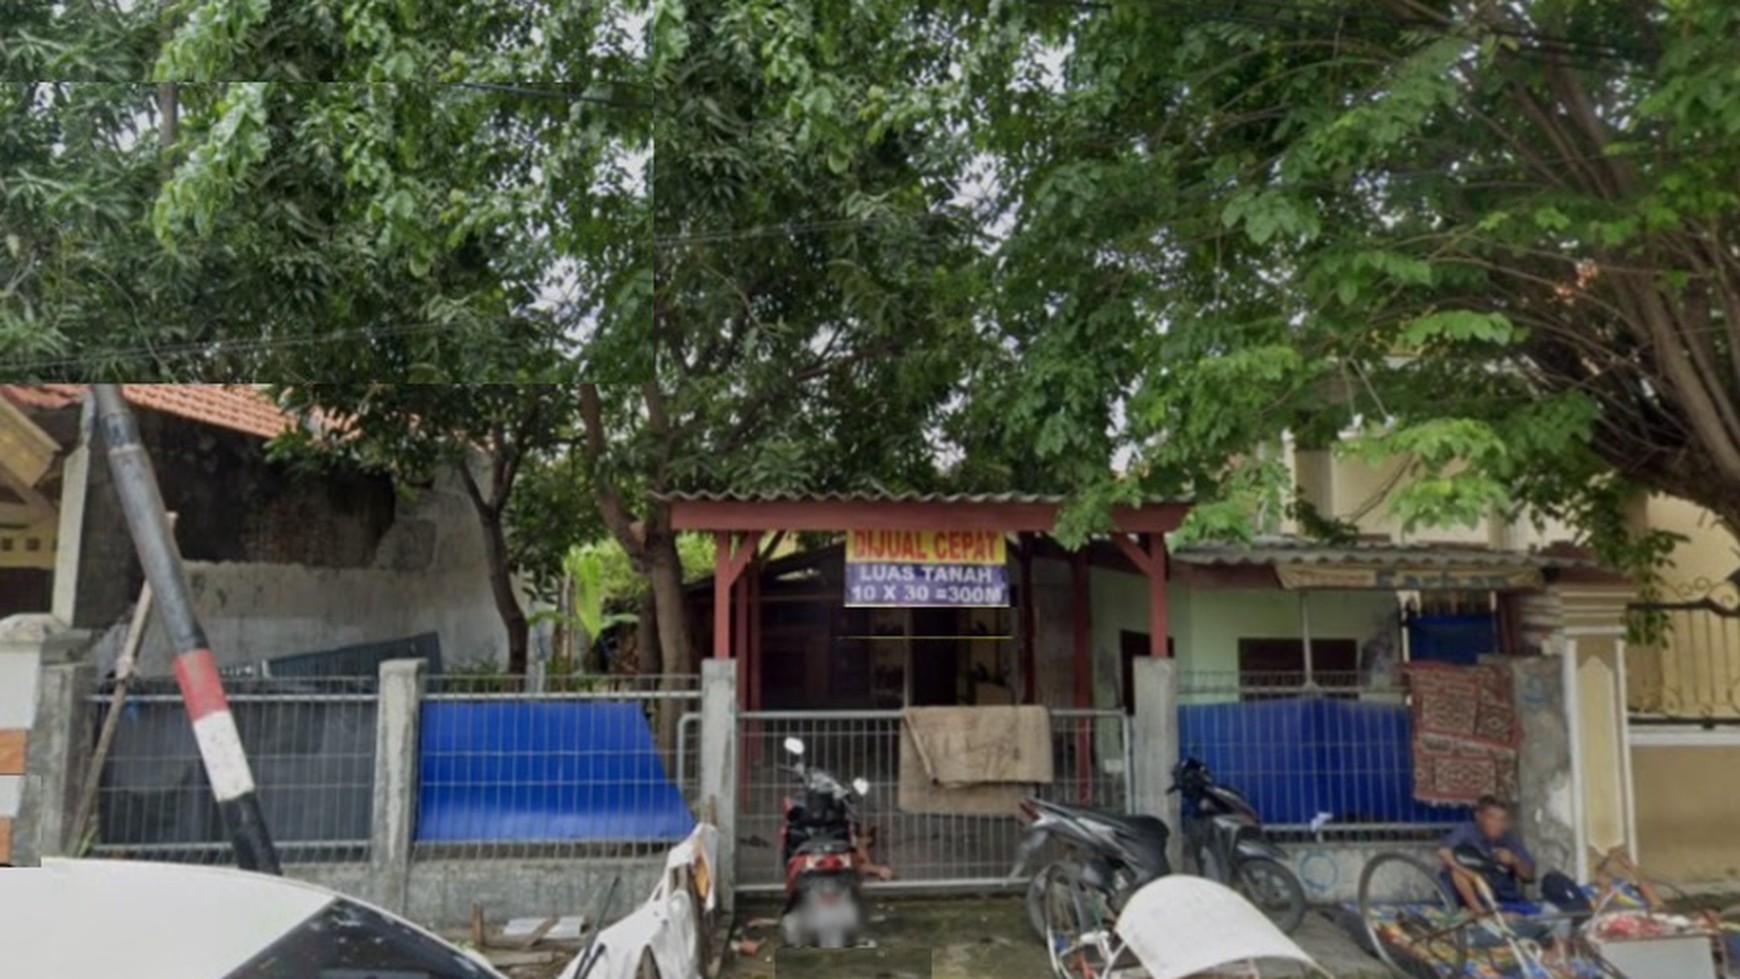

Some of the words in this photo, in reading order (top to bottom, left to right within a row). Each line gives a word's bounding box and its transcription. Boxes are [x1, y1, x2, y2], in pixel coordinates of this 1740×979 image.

[853, 529, 927, 559] DIJUAL
[934, 529, 998, 560] CEPAT
[860, 565, 915, 582] LUAS
[921, 567, 992, 583] TANAH
[852, 585, 876, 601] 10
[882, 585, 896, 600] X
[904, 585, 928, 601] 30
